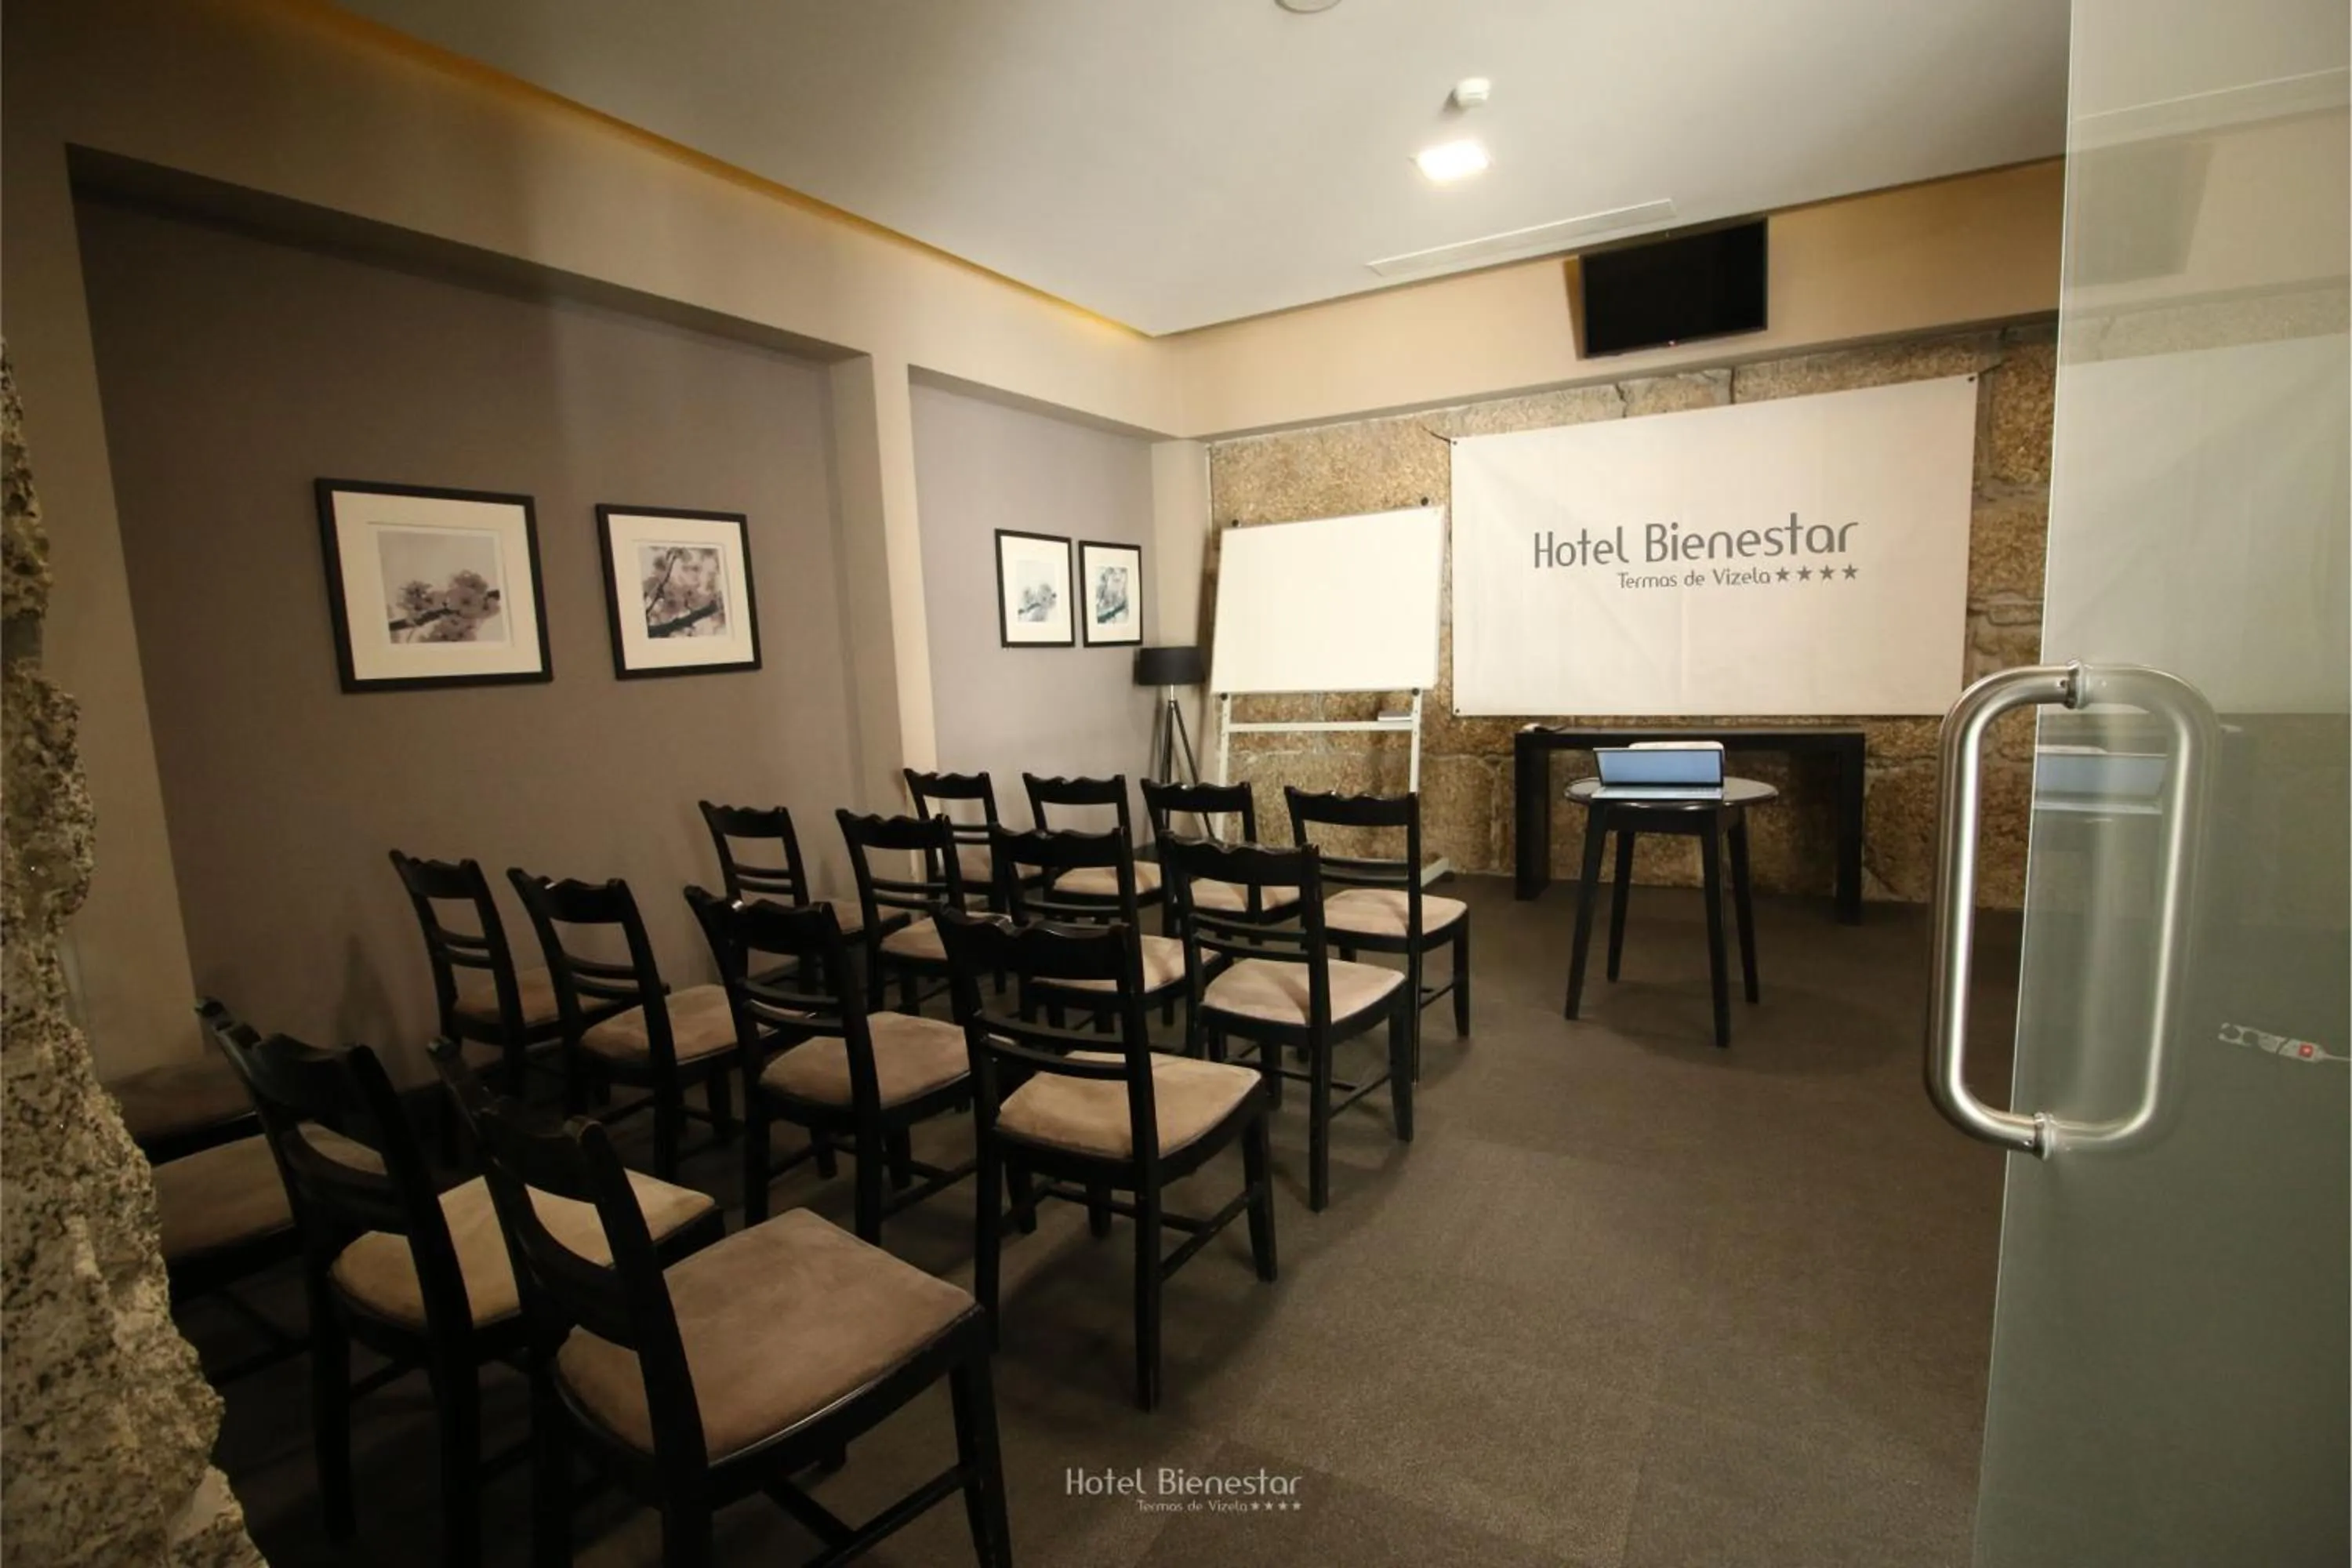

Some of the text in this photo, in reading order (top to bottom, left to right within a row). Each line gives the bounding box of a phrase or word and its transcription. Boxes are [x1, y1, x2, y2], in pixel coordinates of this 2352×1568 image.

[1534, 512, 1859, 569] Hotel Bienestar
[1617, 567, 1770, 590] Termas de Vizela
